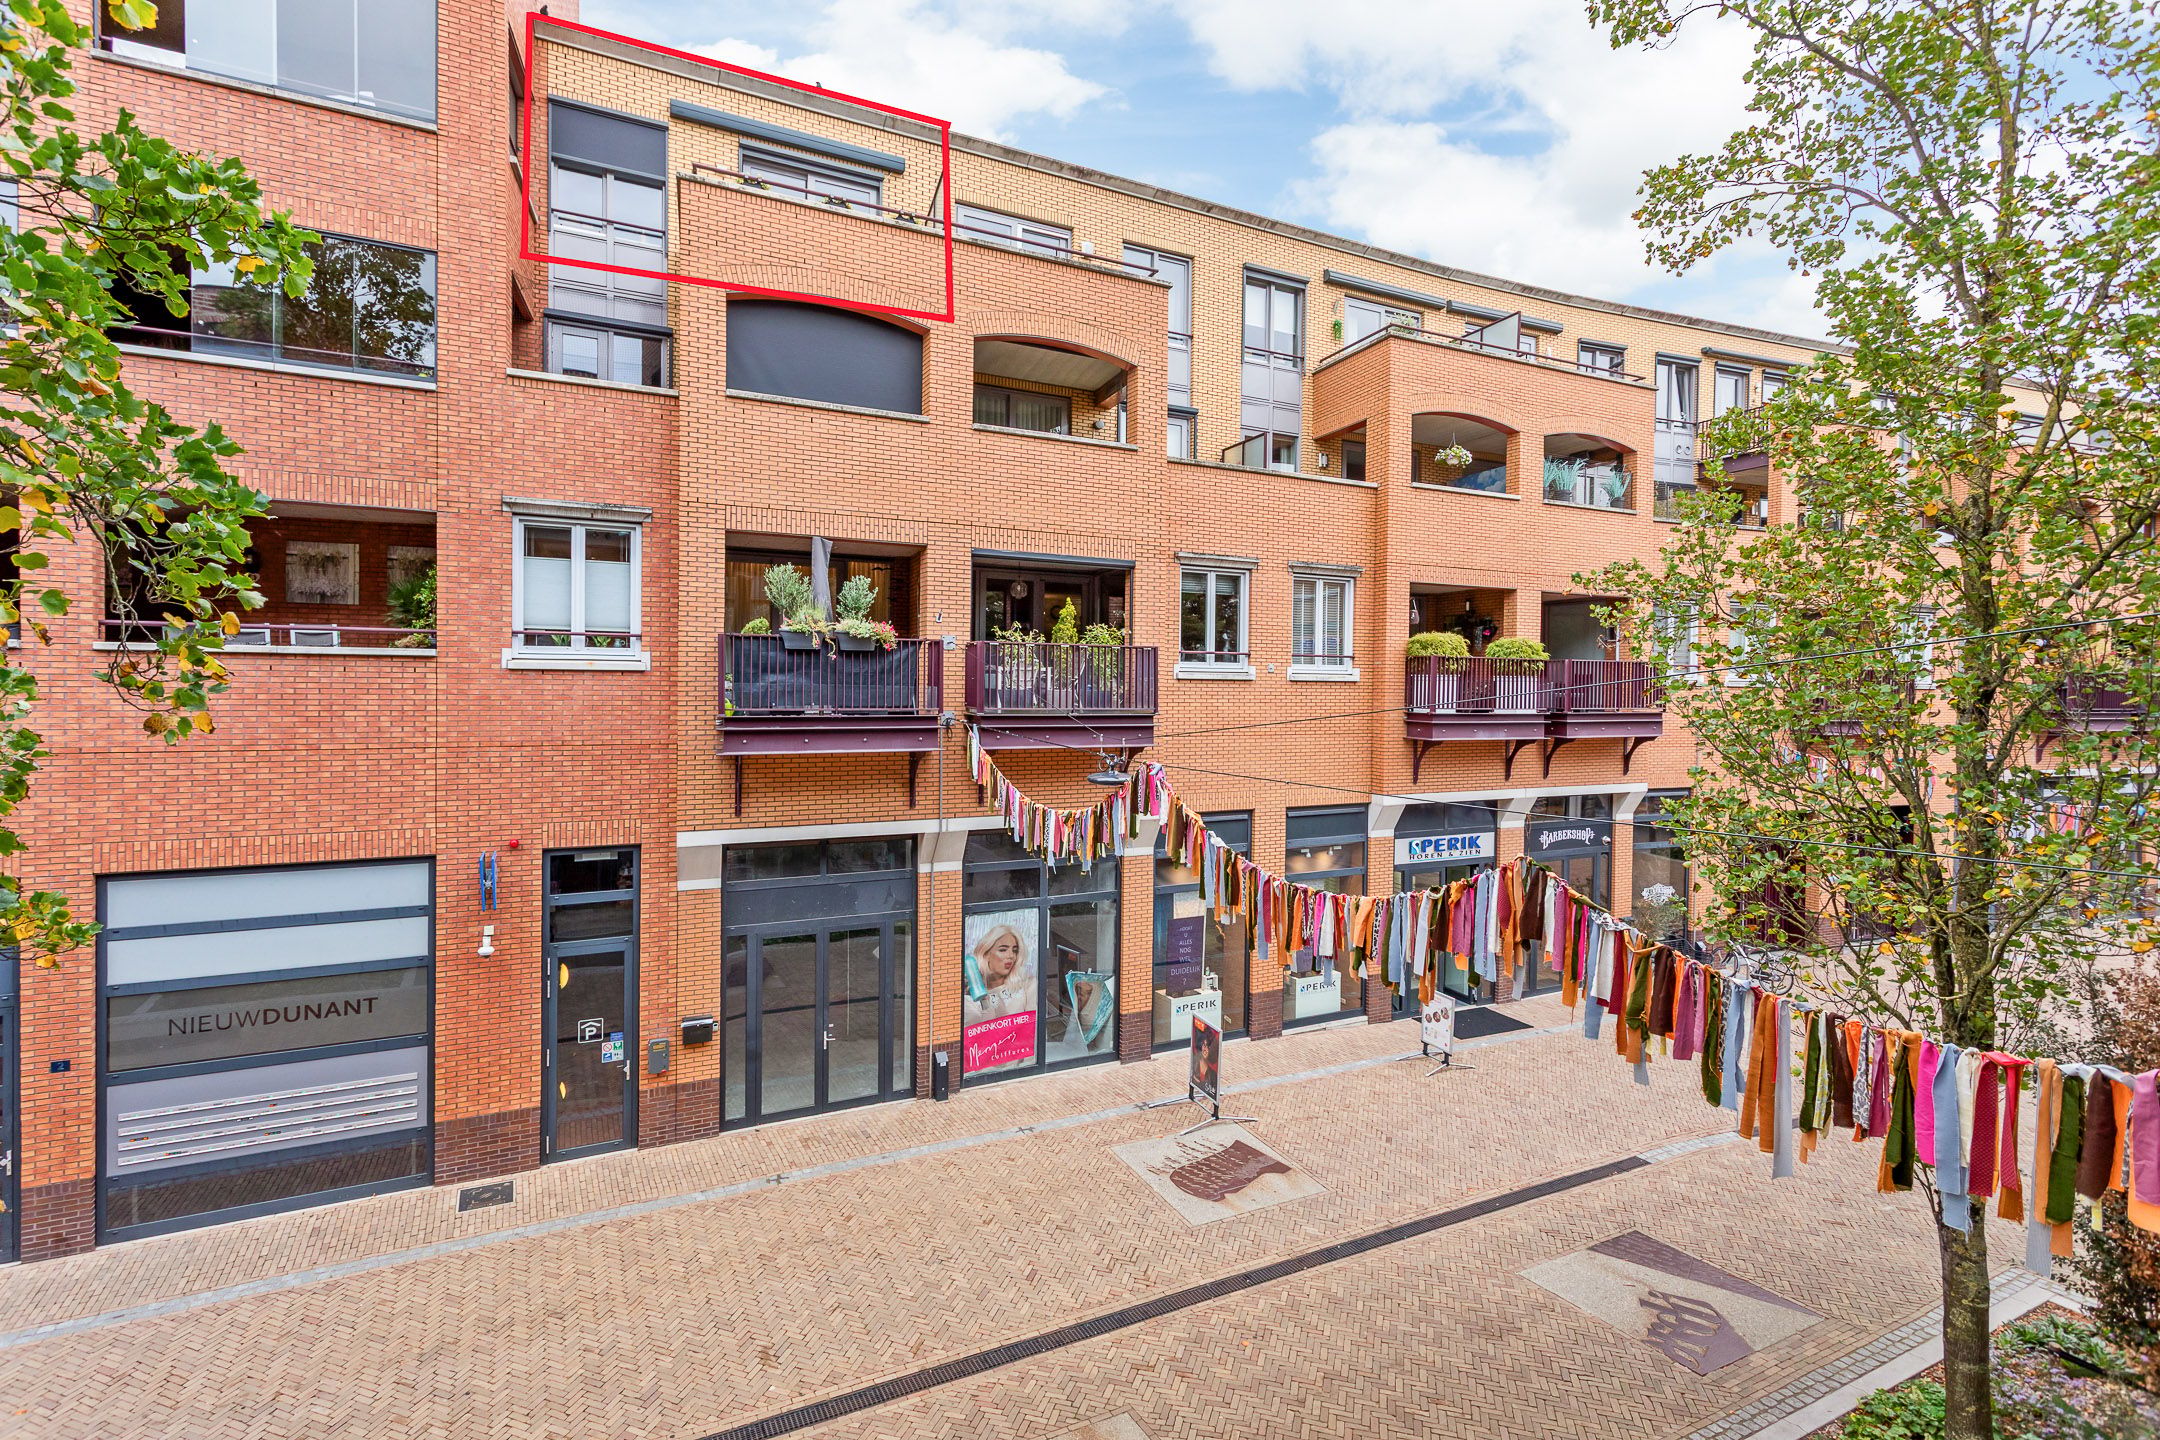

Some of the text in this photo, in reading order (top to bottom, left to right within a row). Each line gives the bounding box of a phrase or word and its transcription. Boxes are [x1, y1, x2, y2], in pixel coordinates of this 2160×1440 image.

[1421, 835, 1481, 852] PERIK
[1540, 828, 1594, 849] BARBERSHOP
[1170, 965, 1201, 976] DUIDELIJK
[1306, 980, 1336, 991] PERK
[1182, 999, 1217, 1012] PERIK
[168, 997, 379, 1036] NIEUWDUNANT
[585, 1026, 597, 1040] P
[967, 1018, 1012, 1037] BINNENKORT
